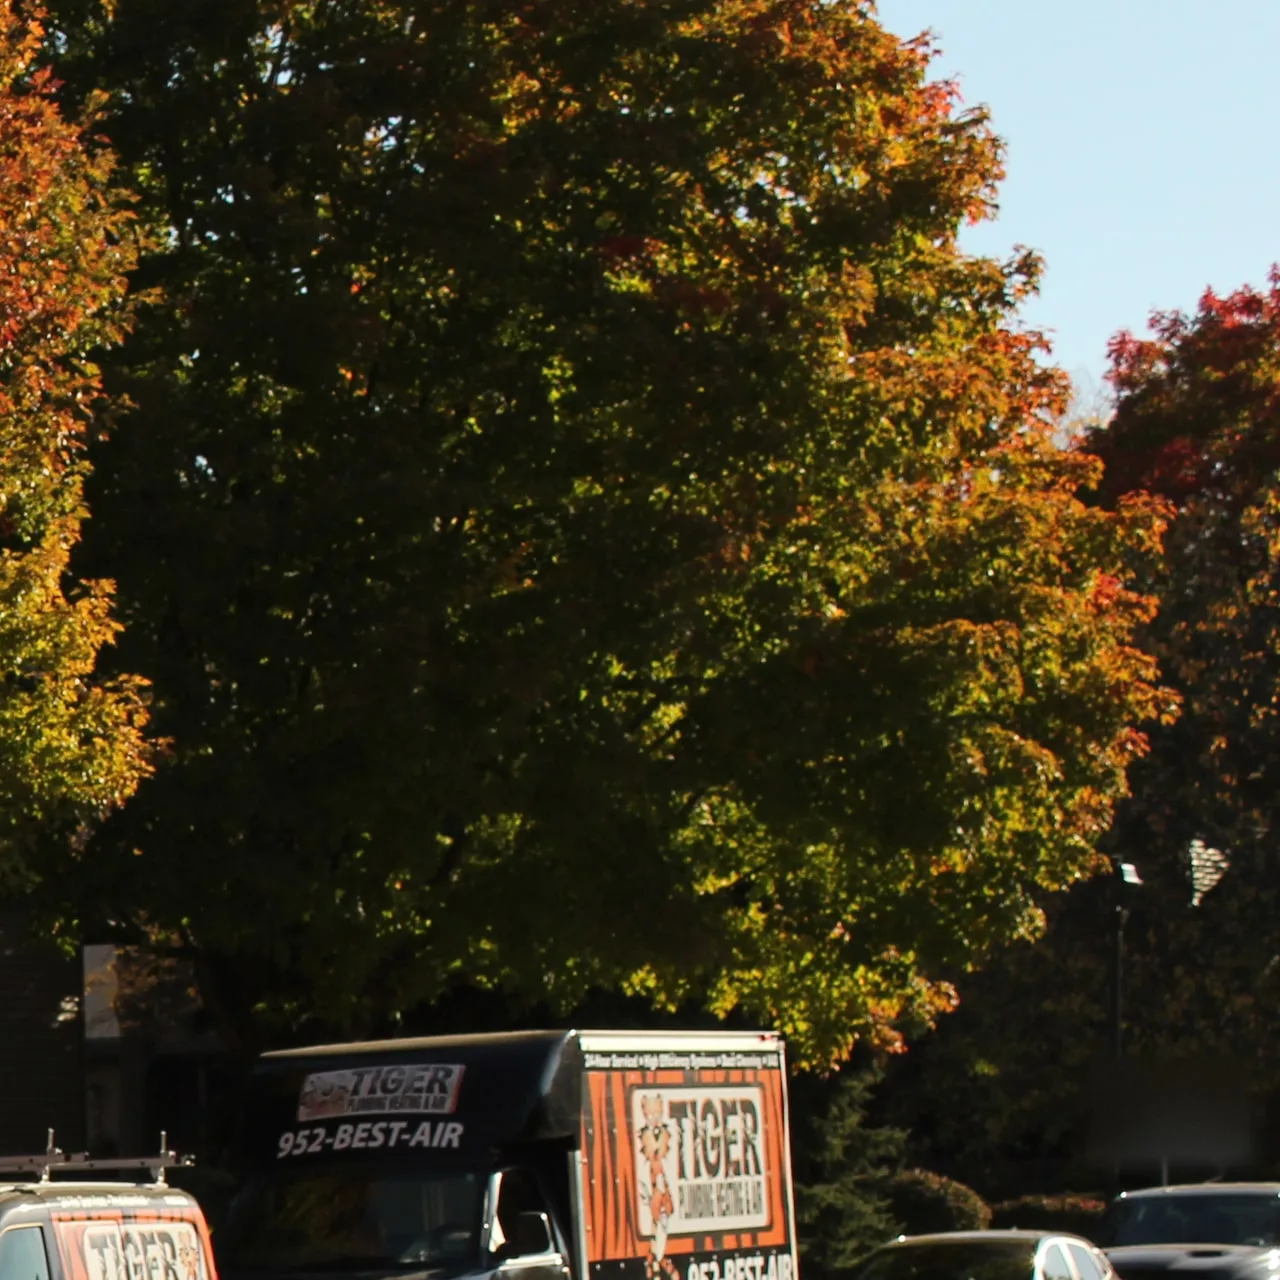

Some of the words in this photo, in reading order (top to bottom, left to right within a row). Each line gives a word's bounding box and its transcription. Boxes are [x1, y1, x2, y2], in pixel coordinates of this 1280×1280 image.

[349, 1066, 453, 1096] TIGER
[276, 1122, 464, 1159] 952-BEST-AIR
[669, 1099, 762, 1179] TIGER
